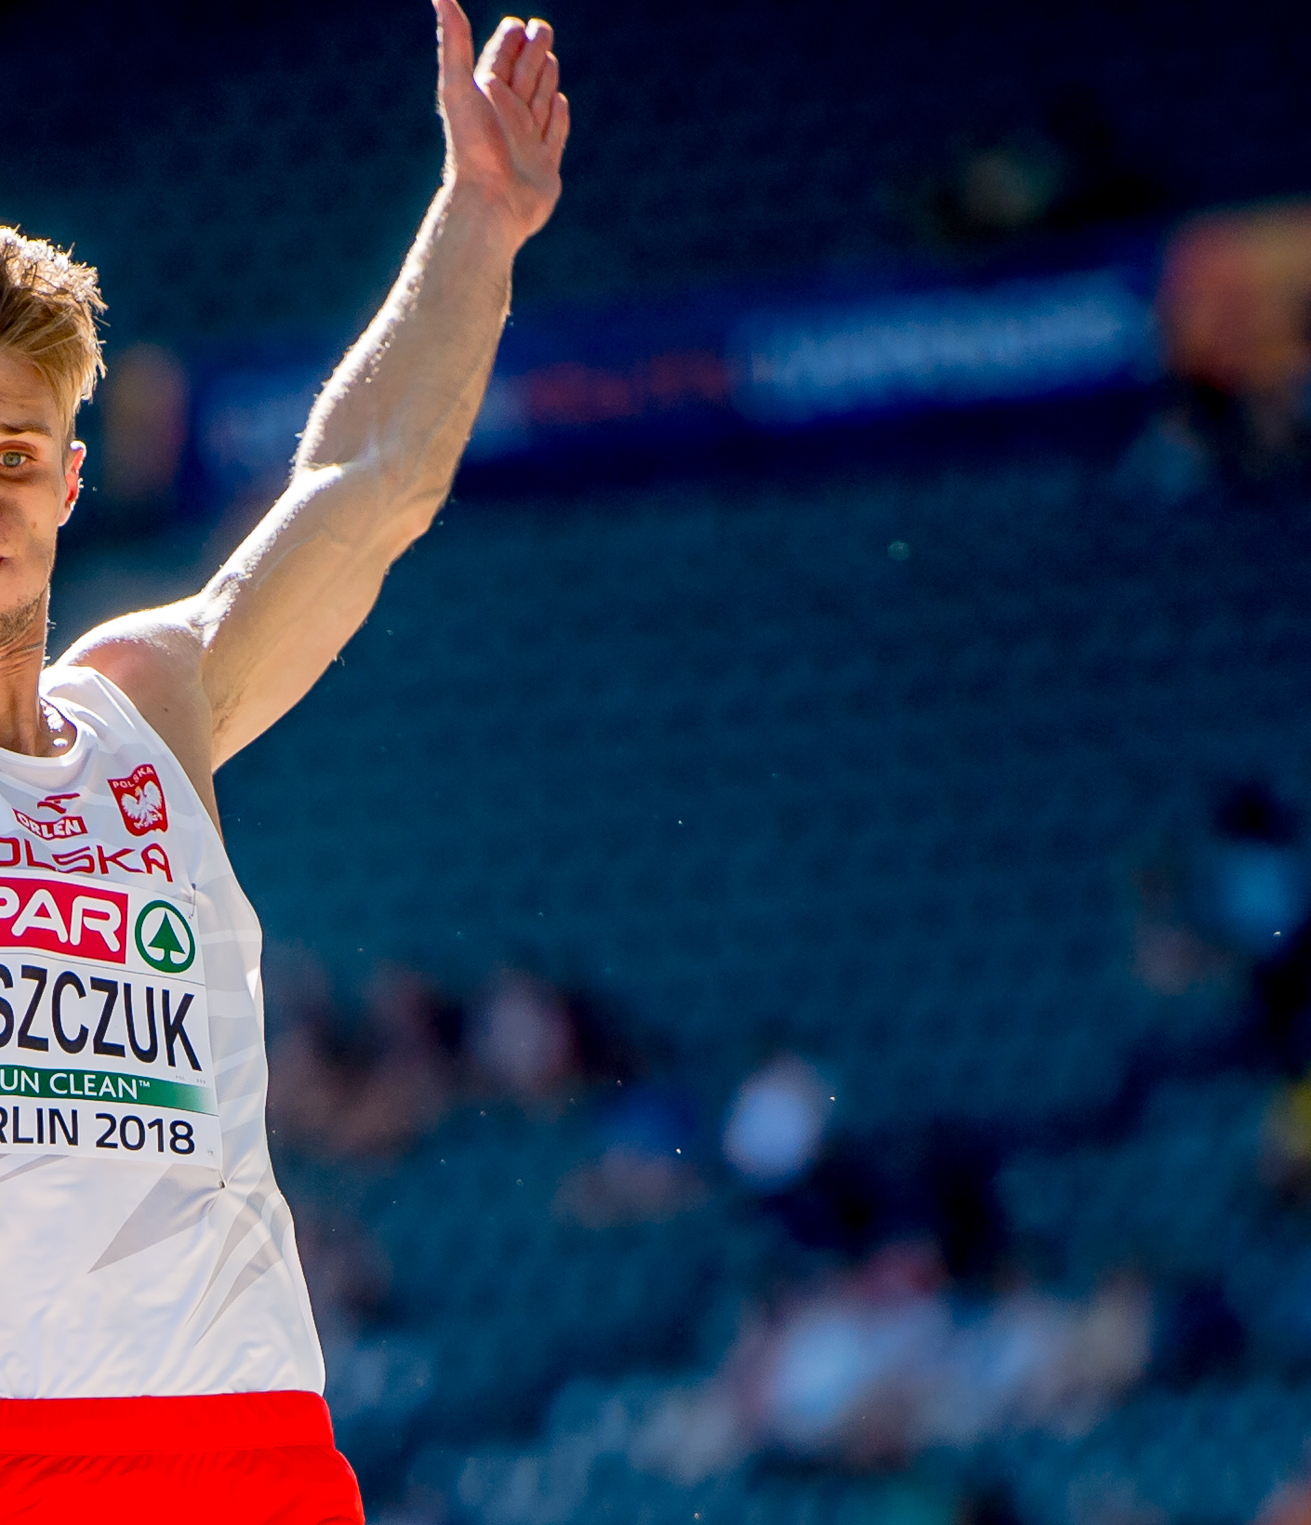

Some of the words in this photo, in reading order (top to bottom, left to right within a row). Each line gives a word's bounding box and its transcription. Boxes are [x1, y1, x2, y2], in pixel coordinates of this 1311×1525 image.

[112, 766, 154, 789] POLSKA
[16, 812, 82, 838] ORLEN
[95, 1112, 196, 1154] 2018
